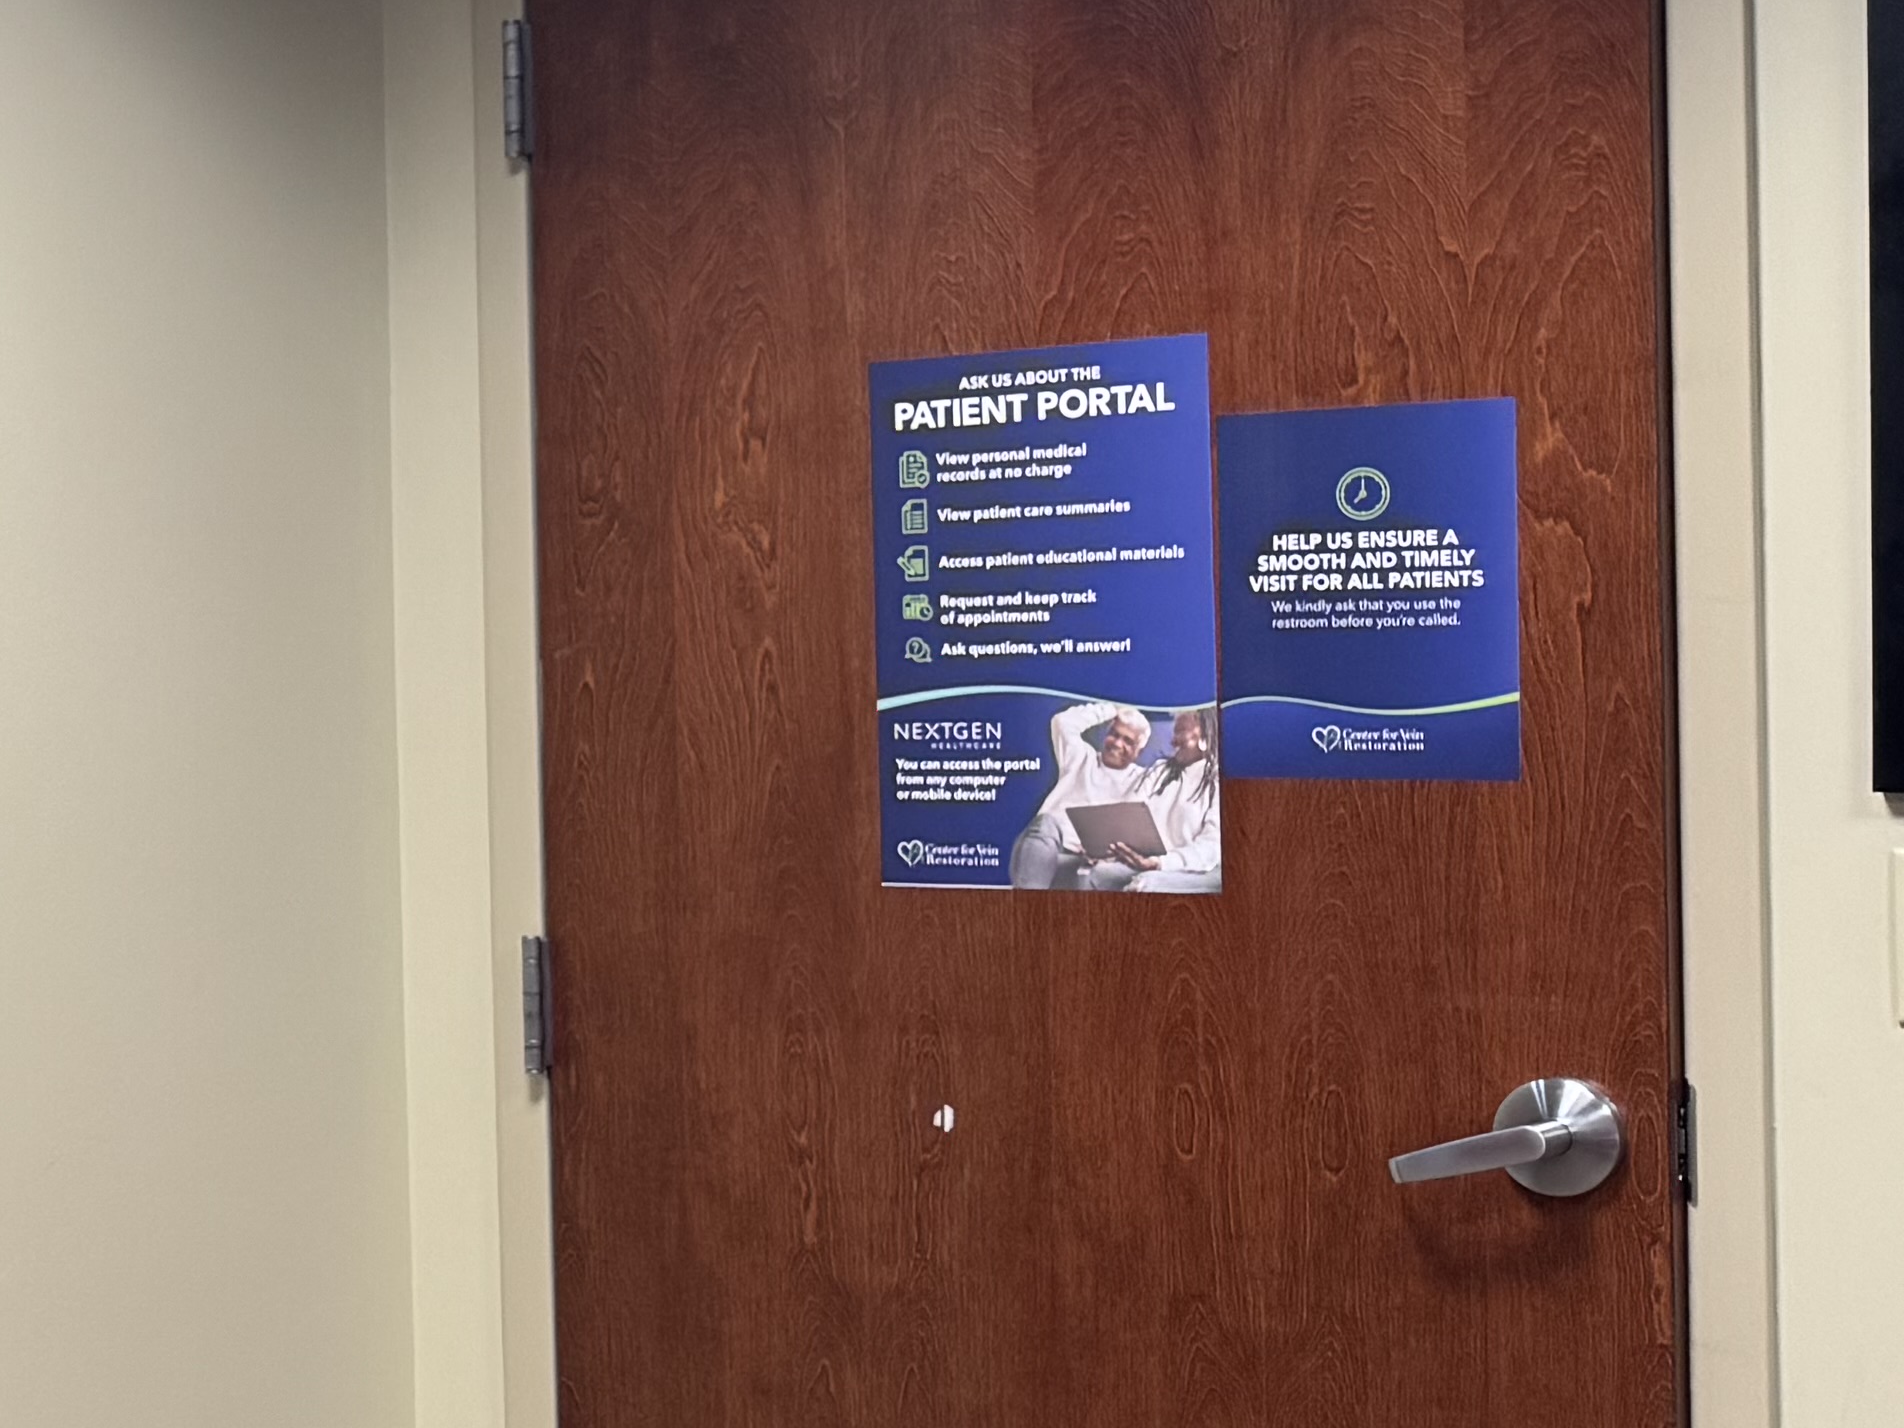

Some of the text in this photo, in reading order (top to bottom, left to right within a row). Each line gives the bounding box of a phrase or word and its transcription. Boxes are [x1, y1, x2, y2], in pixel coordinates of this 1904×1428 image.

[959, 366, 1100, 390] ASK US ABOUT THE
[894, 382, 1175, 431] PATIENT PORTAL
[936, 443, 1086, 466] View personal medical
[936, 463, 1072, 482] records at no charge
[937, 499, 1130, 523] View patient care summaries
[1273, 529, 1459, 551] HELP US ENSURE A
[939, 545, 1185, 570] Access patient educational materials
[1257, 549, 1475, 572] SMOOTH AND TIMELY
[1249, 570, 1484, 592] VISIT FOR ALL PATIENTS
[940, 589, 1096, 610] Request and keep track
[1271, 597, 1460, 614] We kindly ask that you use the
[941, 610, 1050, 627] of appointments
[1272, 617, 1328, 629] restroom
[1332, 614, 1373, 628] before
[1419, 613, 1460, 626] called.
[941, 643, 966, 656] Ask
[969, 641, 1037, 658] questions,
[1077, 638, 1130, 652] answer!
[894, 722, 1002, 740] NEXTGEN
[896, 758, 1040, 772] You can access the portal
[896, 773, 1006, 787] from any computer
[896, 790, 910, 800] or
[912, 788, 951, 800] mobile
